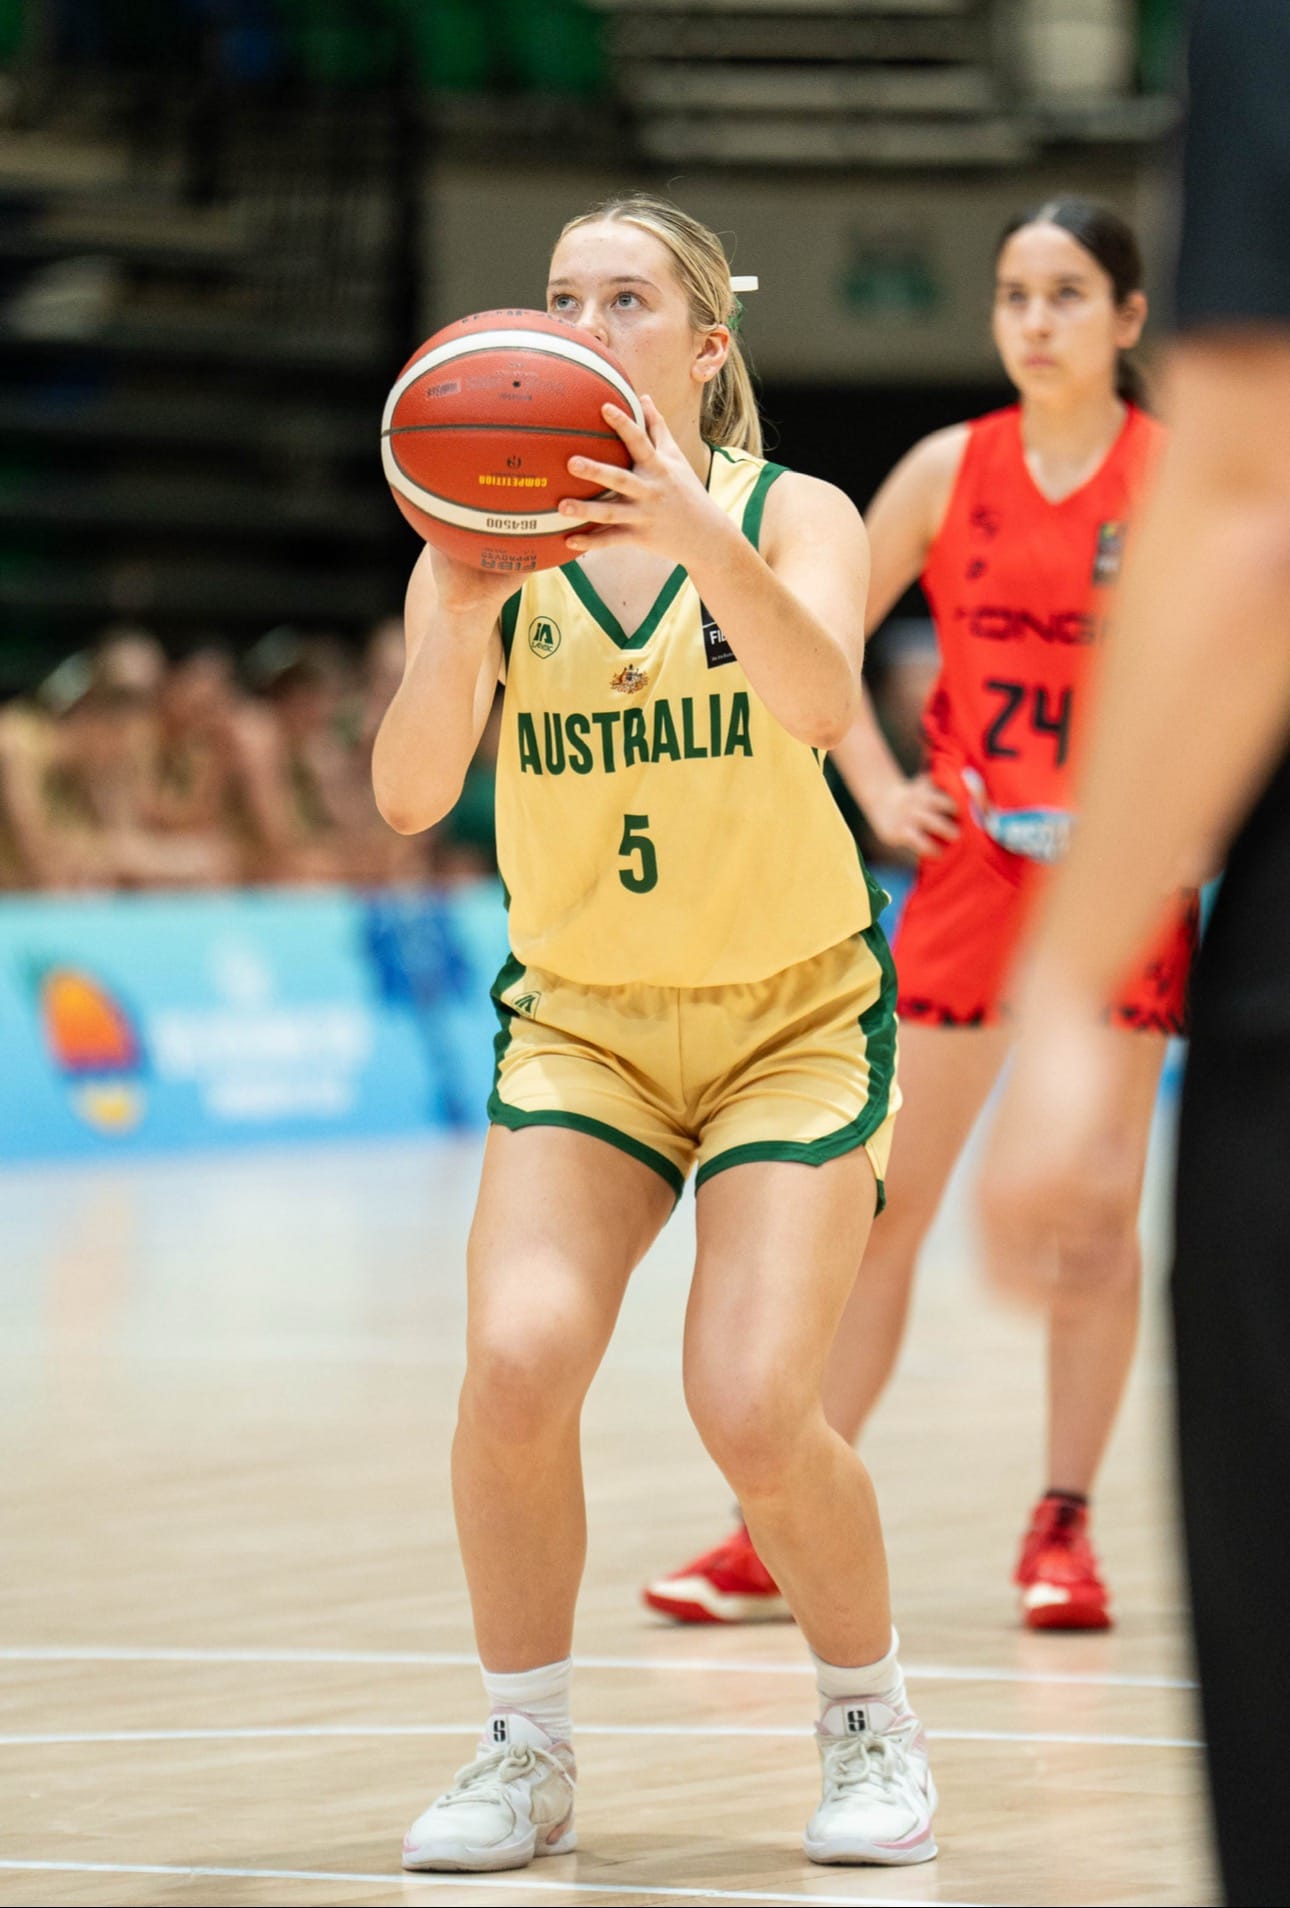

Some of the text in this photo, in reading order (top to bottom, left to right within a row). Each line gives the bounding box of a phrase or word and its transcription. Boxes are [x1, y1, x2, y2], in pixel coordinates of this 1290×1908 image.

[478, 475, 548, 488] COMPETITION
[486, 517, 537, 531] BG4500
[953, 605, 1110, 646] ONG
[517, 692, 754, 775] AUSTRALIA
[985, 679, 1073, 768] 24
[618, 814, 659, 894] 5
